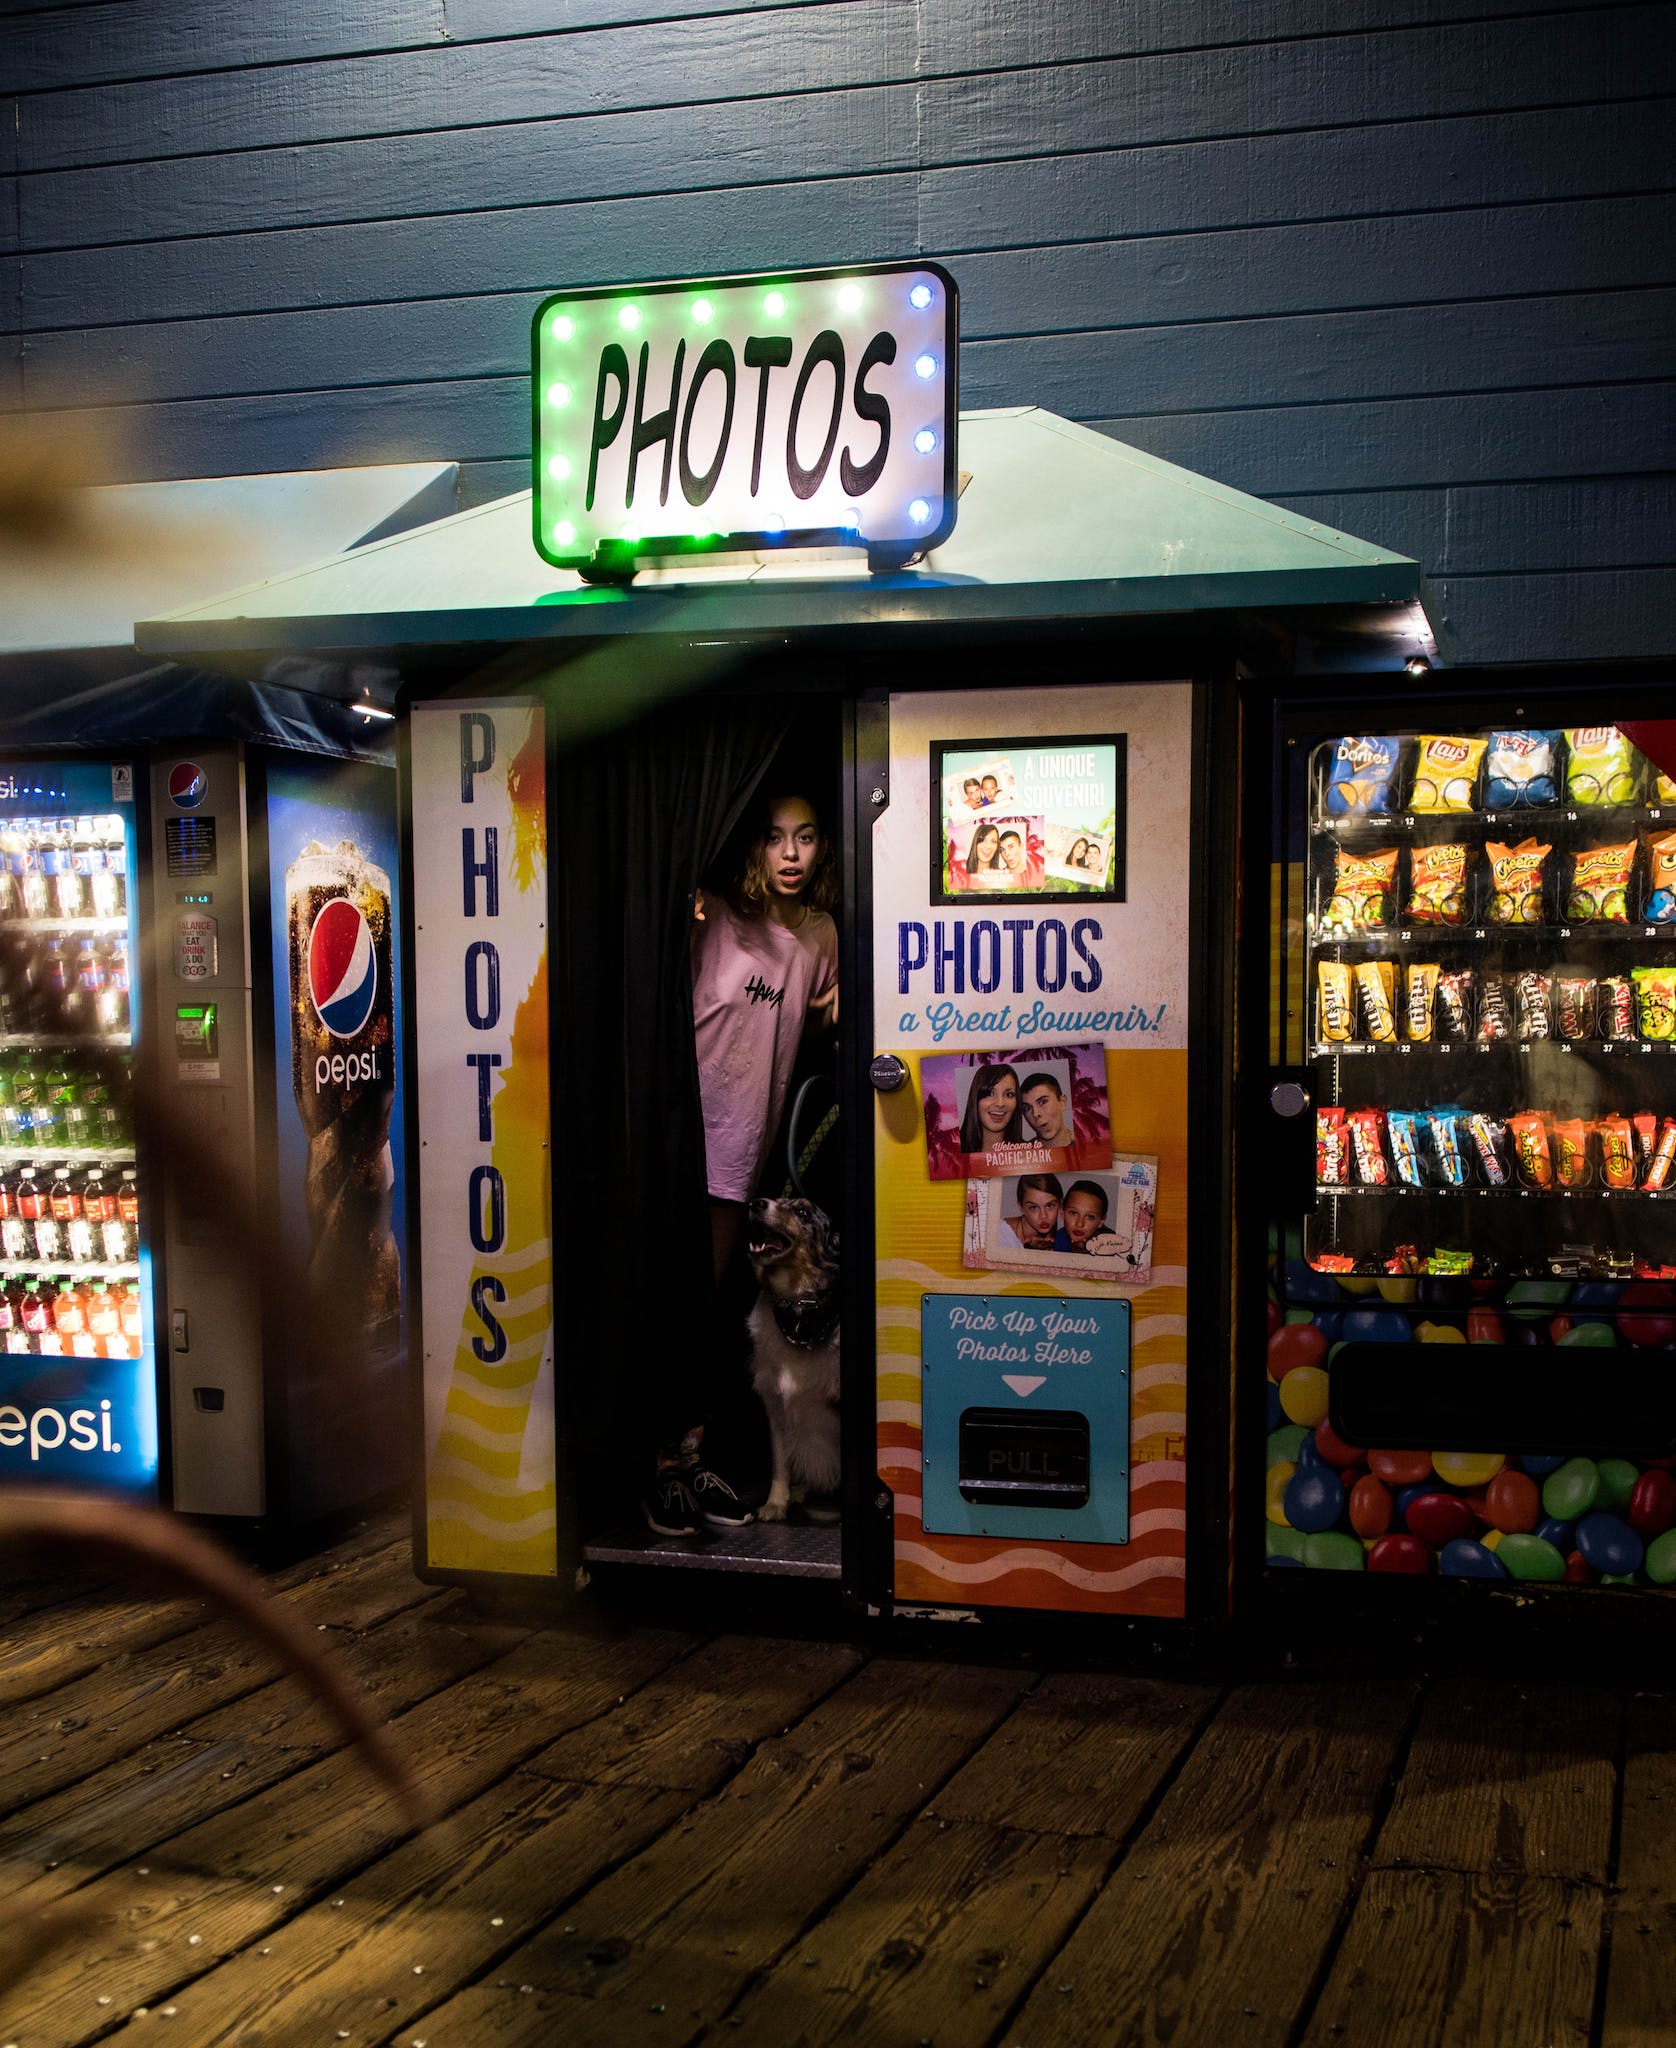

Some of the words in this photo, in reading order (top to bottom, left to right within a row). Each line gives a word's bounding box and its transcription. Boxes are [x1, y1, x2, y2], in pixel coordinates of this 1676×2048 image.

[586, 329, 898, 512] PHOTOS
[1336, 745, 1391, 765] Doritos
[1428, 739, 1467, 762] Lay's
[1024, 755, 1035, 780] A
[1039, 752, 1096, 780] UNIQUE
[1023, 782, 1105, 809] SOUVENIR!
[1566, 812, 1578, 821] 16
[1649, 809, 1661, 818] 18
[1404, 816, 1415, 825] 12
[1486, 814, 1497, 823] 14
[1495, 855, 1542, 881] Cheetos
[1321, 932, 1333, 941] 20
[1401, 931, 1412, 940] 22
[1475, 930, 1486, 938] 24
[1560, 928, 1571, 937] 26
[1645, 927, 1656, 937] 28
[186, 937, 200, 945] EAT
[182, 946, 206, 955] DRINK
[192, 955, 204, 964] DO
[898, 918, 1104, 994] PHOTOS
[899, 1012, 920, 1032] a
[925, 1001, 1012, 1043] Great
[1016, 1000, 1164, 1040] Souvenir!
[460, 712, 507, 1364] PHOTOS
[1366, 1044, 1376, 1053] 31
[1400, 1044, 1411, 1053] 32
[1440, 1044, 1450, 1053] 33
[1479, 1044, 1490, 1053] 34
[1520, 1044, 1531, 1053] 35
[1561, 1044, 1572, 1053] 36
[1603, 1044, 1613, 1053] 37
[1641, 1044, 1652, 1053] 38
[315, 1044, 377, 1095] pepsi
[991, 1140, 1033, 1152] Welcome
[1034, 1139, 1043, 1149] to
[985, 1150, 1022, 1166] PACIFIC
[1026, 1149, 1053, 1164] PARK
[949, 1306, 999, 1331] Pick
[1001, 1310, 1039, 1337] Up
[1041, 1311, 1101, 1341] Your
[956, 1337, 1032, 1361] Photos
[1034, 1341, 1094, 1367] Here
[0, 1398, 112, 1461] epsi
[988, 1449, 1060, 1477] PULL
